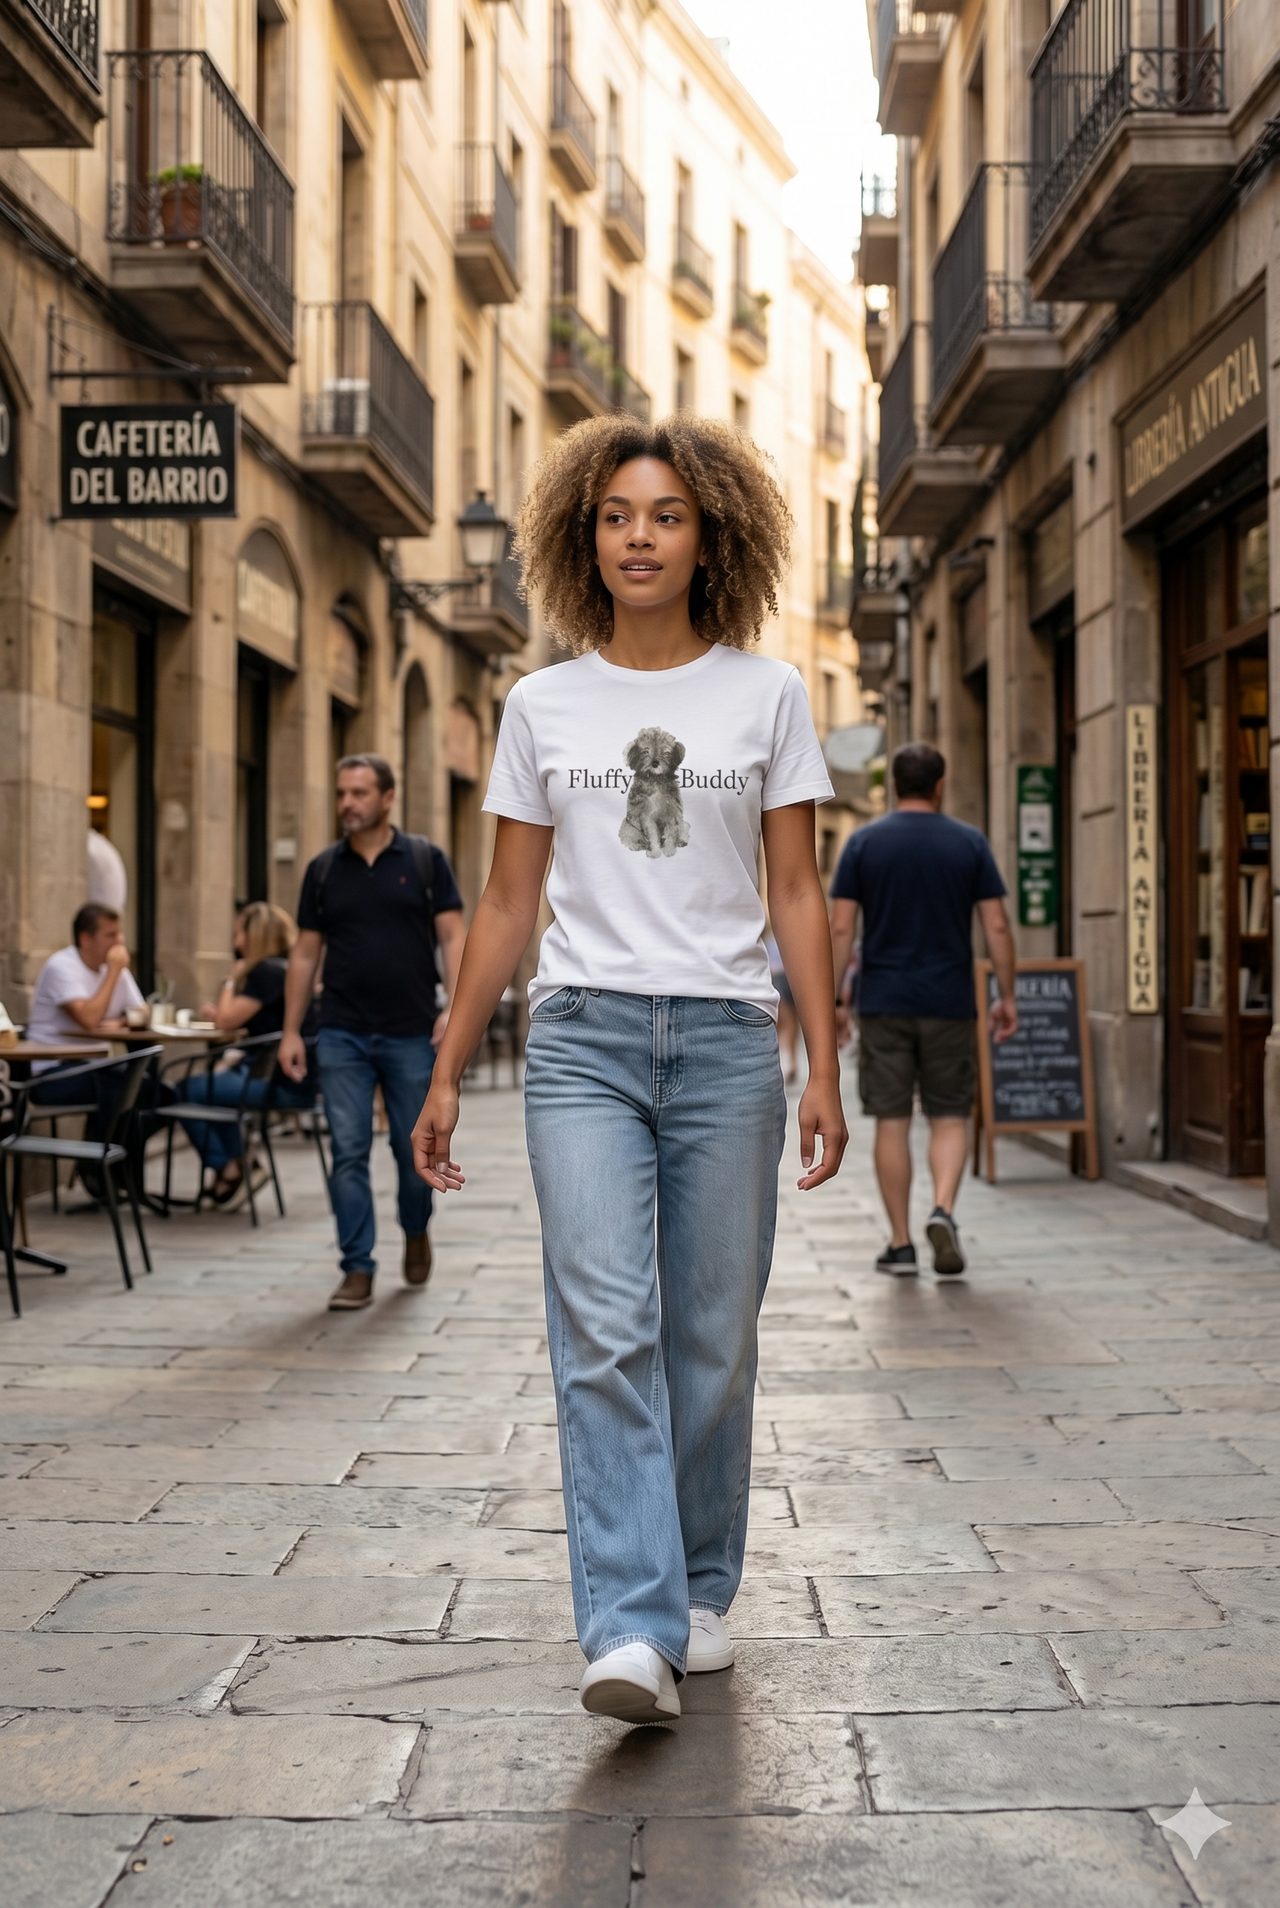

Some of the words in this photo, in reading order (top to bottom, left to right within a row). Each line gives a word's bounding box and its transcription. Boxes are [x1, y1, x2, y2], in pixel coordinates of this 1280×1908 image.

[76, 410, 221, 458] CAFETERÍA
[1125, 391, 1187, 498] LIBRERÍA
[1188, 336, 1261, 449] ANTIGUA
[70, 467, 121, 504] DEL
[127, 466, 228, 504] BARRIO
[567, 768, 633, 794] Fluffy
[680, 768, 749, 796] Buddy
[1134, 876, 1151, 1006] ANTIGUA
